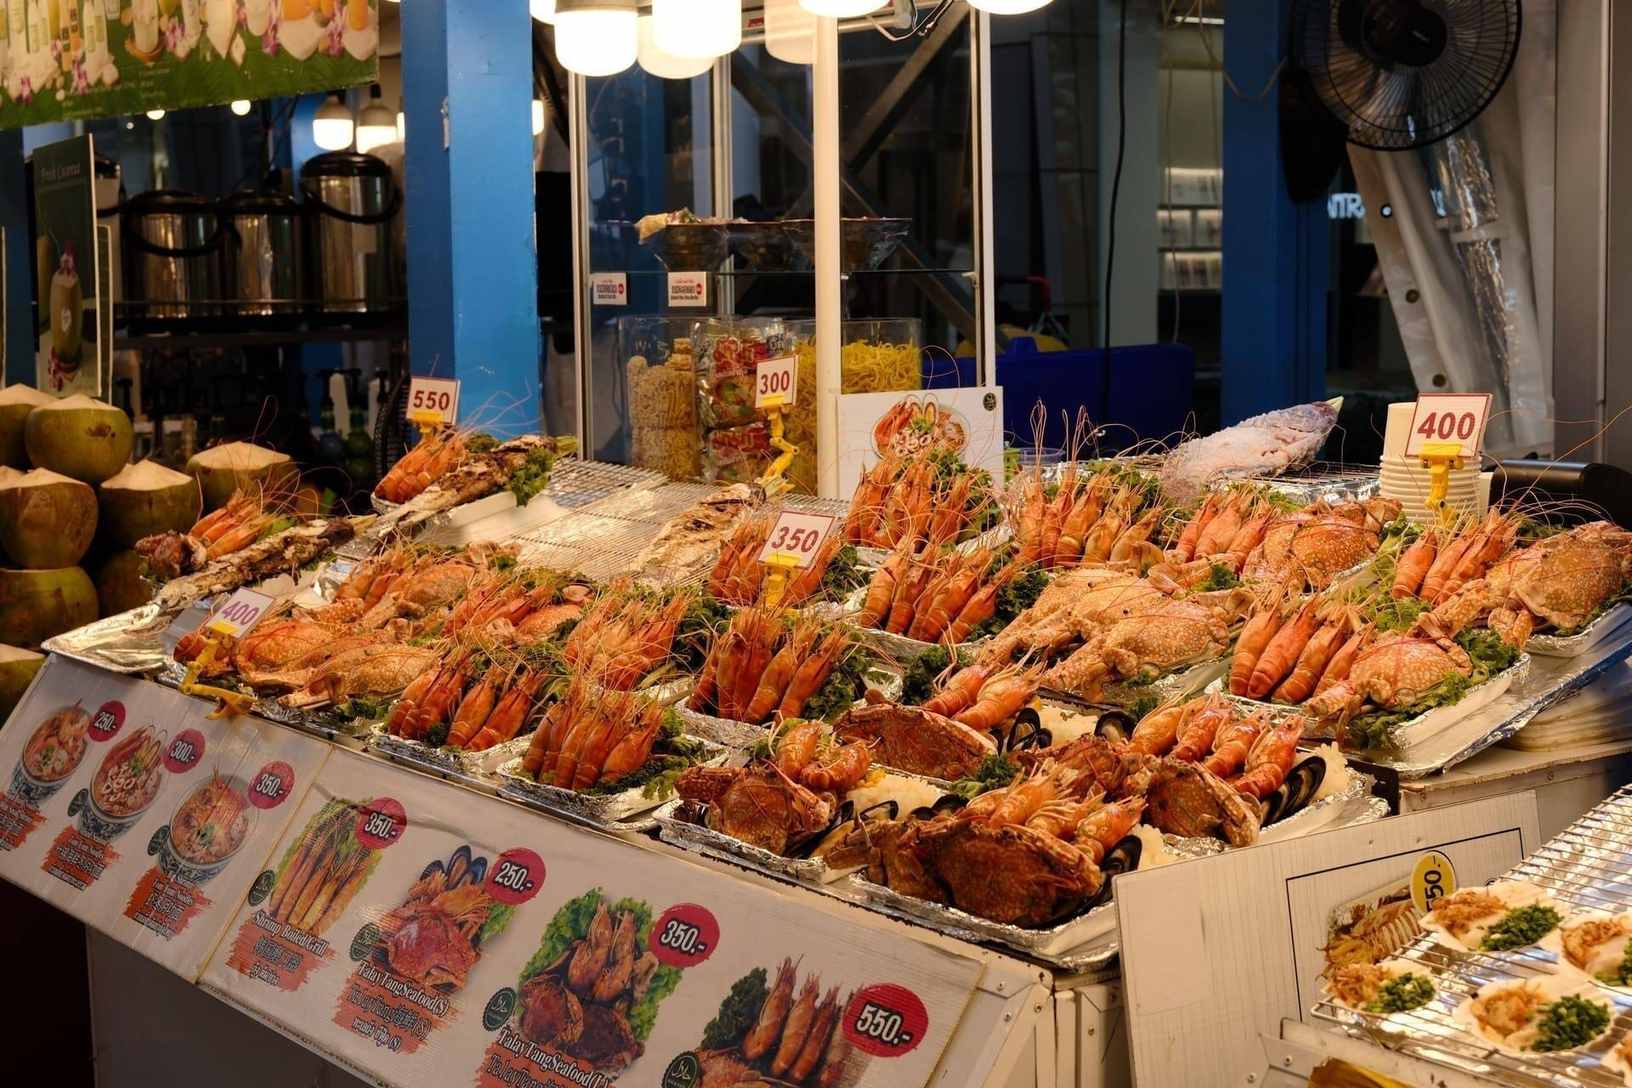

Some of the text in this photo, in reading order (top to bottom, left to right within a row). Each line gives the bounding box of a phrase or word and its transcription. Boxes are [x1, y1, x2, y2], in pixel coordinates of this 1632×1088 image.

[760, 370, 790, 395] 300
[413, 390, 450, 411] 550
[1417, 411, 1476, 440] 400
[771, 526, 820, 553] 350
[222, 600, 260, 626] 400
[256, 774, 284, 800] 350.-
[364, 811, 397, 839] 350.-
[494, 861, 533, 891] 250.-
[660, 919, 706, 955] 350.-
[855, 1003, 911, 1045] 550.-
